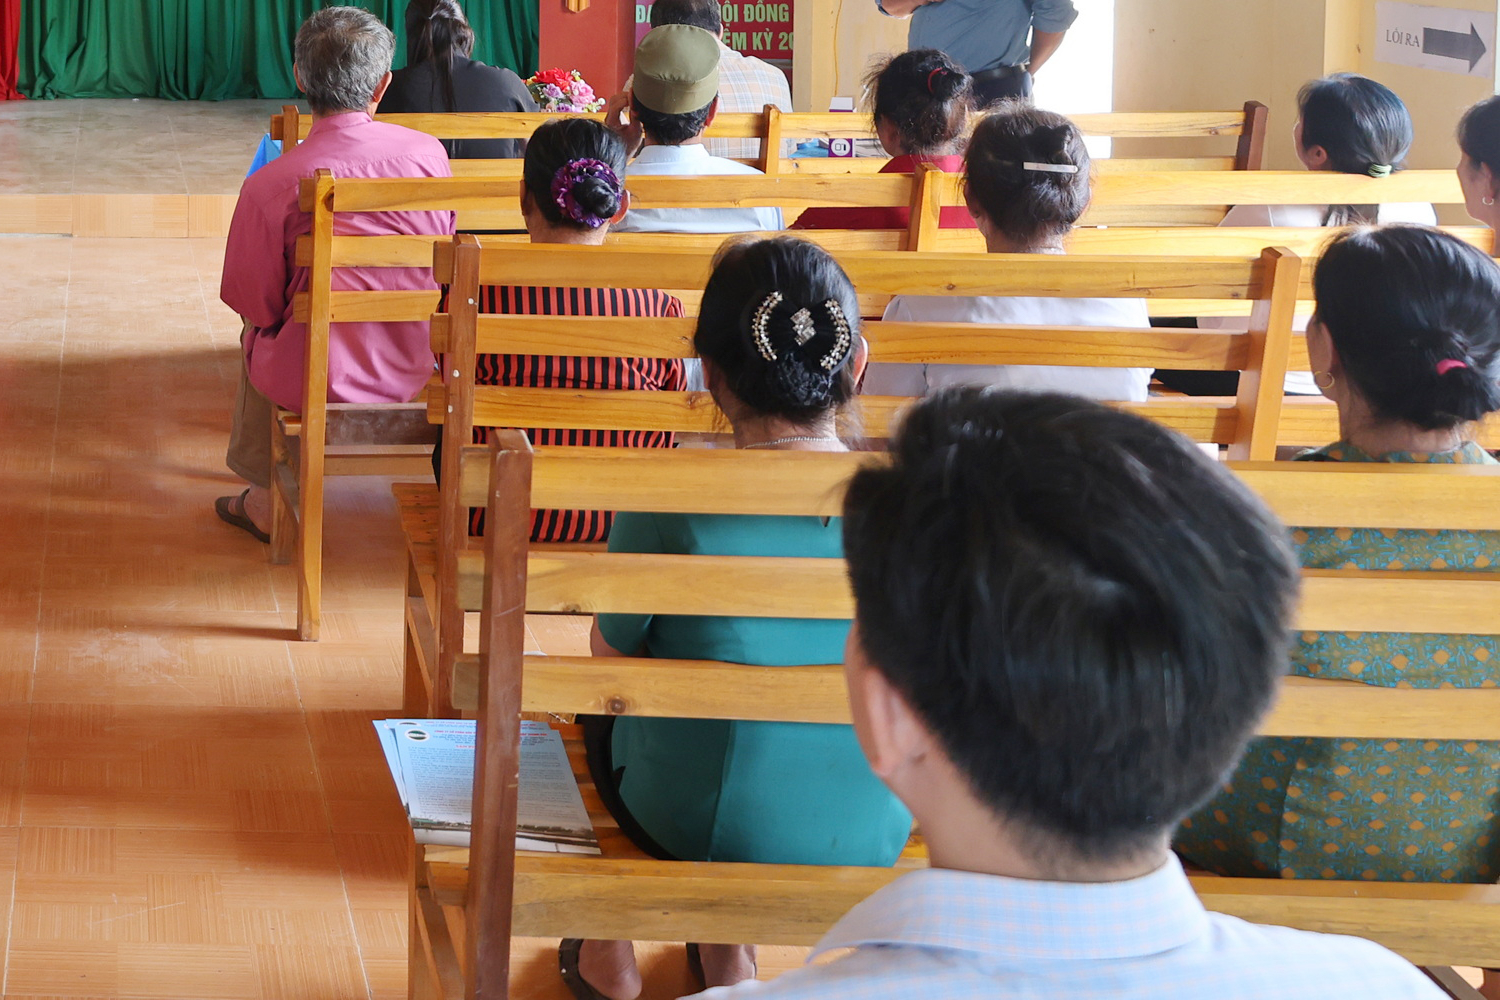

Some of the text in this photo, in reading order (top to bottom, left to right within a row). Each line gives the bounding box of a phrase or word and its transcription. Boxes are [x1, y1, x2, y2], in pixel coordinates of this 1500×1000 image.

[720, 0, 739, 27] ỘI
[752, 28, 774, 50] KỲ
[1405, 32, 1420, 48] RA
